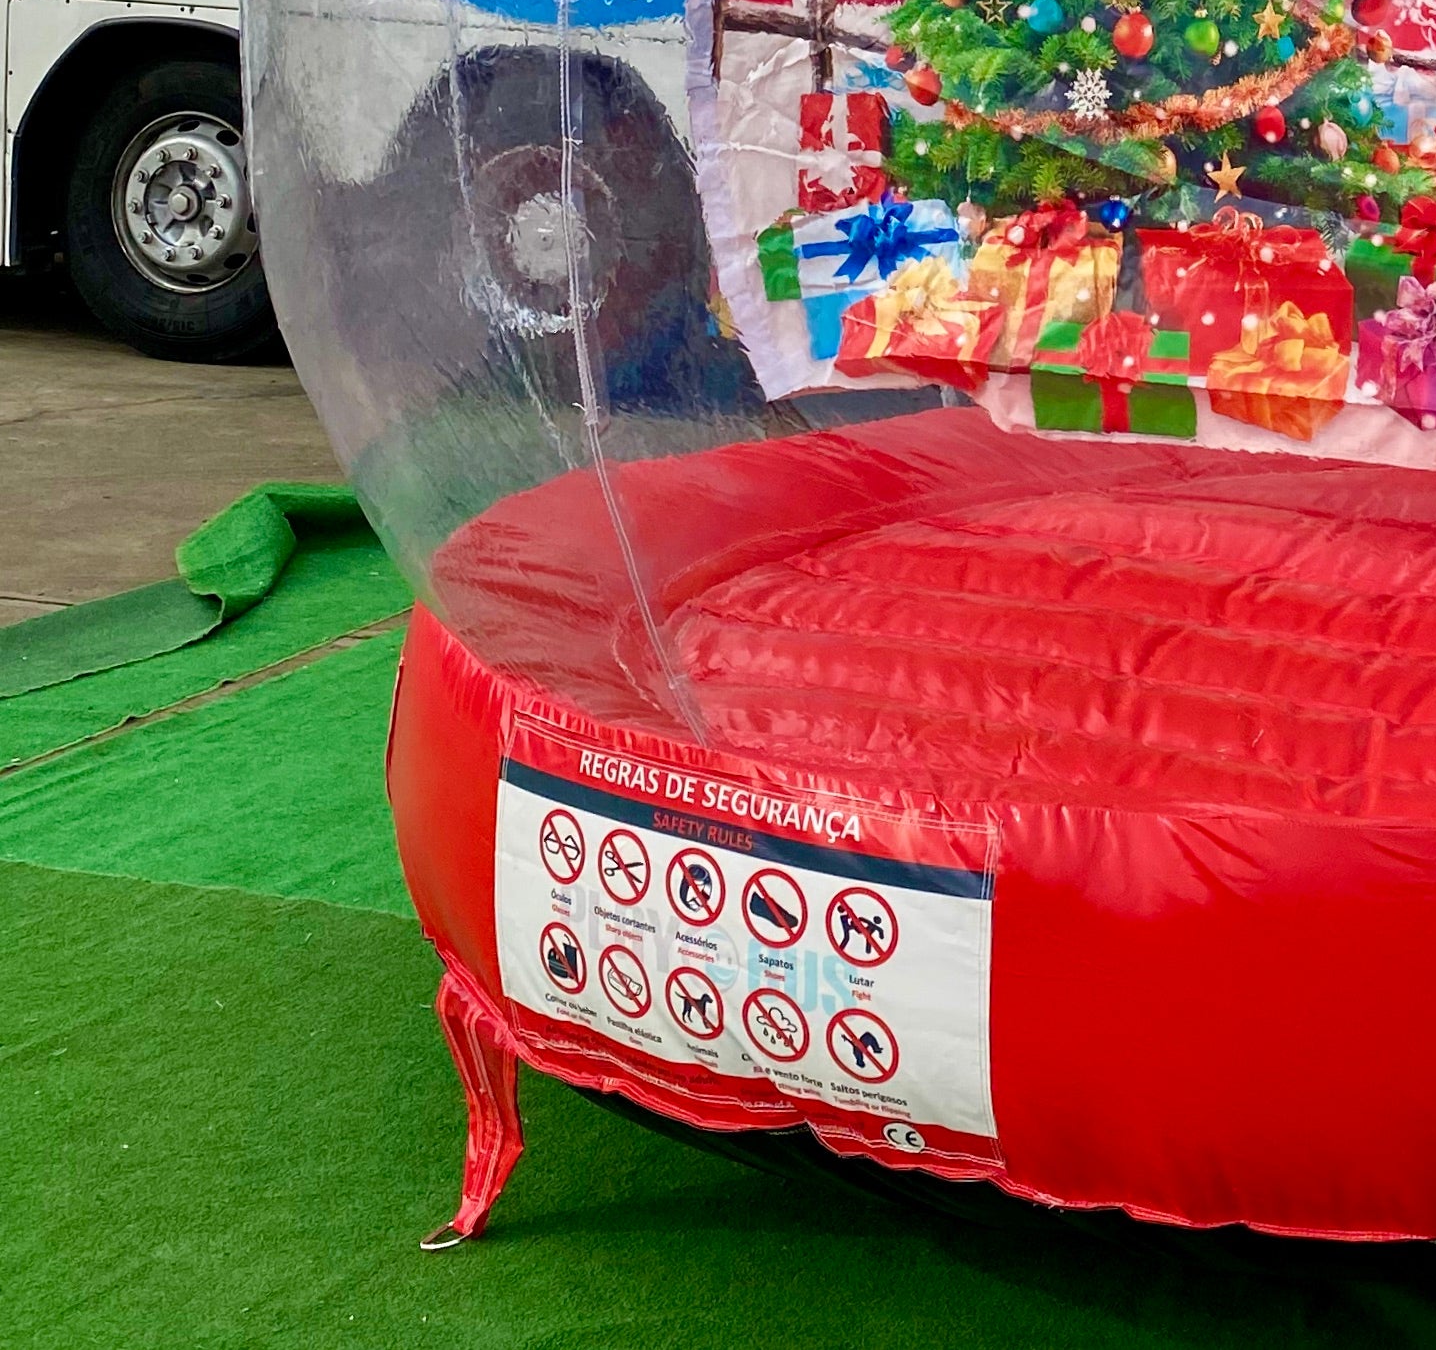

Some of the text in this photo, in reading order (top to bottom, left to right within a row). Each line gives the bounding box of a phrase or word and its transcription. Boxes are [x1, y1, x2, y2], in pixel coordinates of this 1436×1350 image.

[579, 749, 861, 844] REGRAS DE SEGURANÇA
[653, 811, 753, 851] SAFETY RULES
[594, 905, 656, 934] Objetos cortantes
[675, 931, 718, 951] Acessórios
[758, 953, 794, 972] Sapatos
[848, 973, 875, 988] Lutar
[851, 989, 872, 1002] Fight
[772, 1068, 800, 1083] vento
[830, 1081, 908, 1108] Saltos perigosos
[886, 1128, 921, 1148] CE
